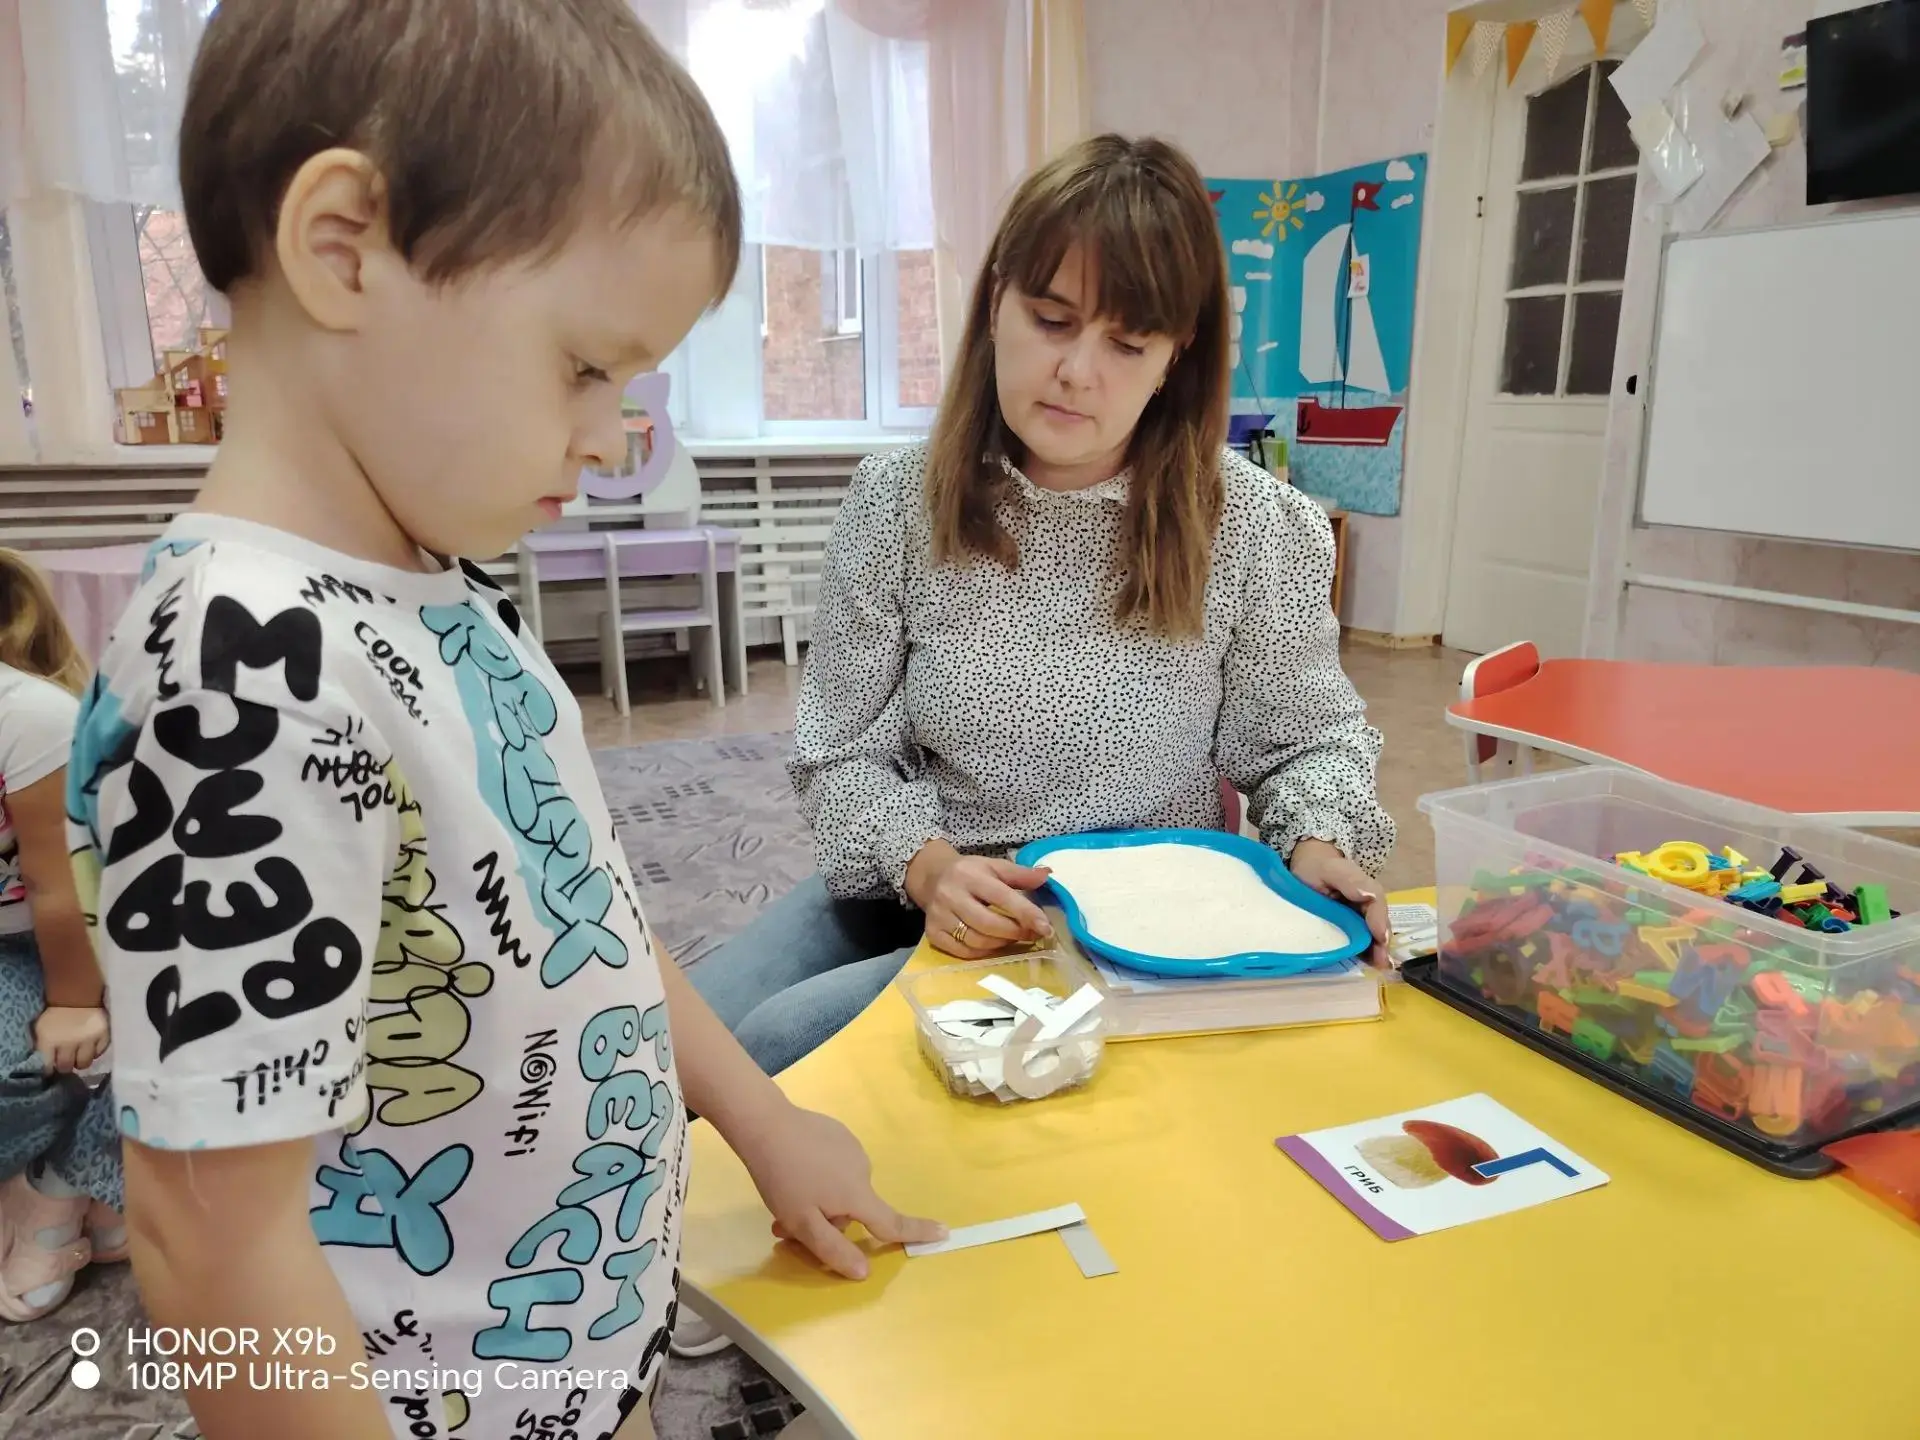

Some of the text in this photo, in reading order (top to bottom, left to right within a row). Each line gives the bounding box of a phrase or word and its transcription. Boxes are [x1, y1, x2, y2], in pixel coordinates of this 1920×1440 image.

[472, 1004, 655, 1364] BEACH
[587, 1000, 676, 1342] PALM
[1343, 1164, 1385, 1195] ГРИБ
